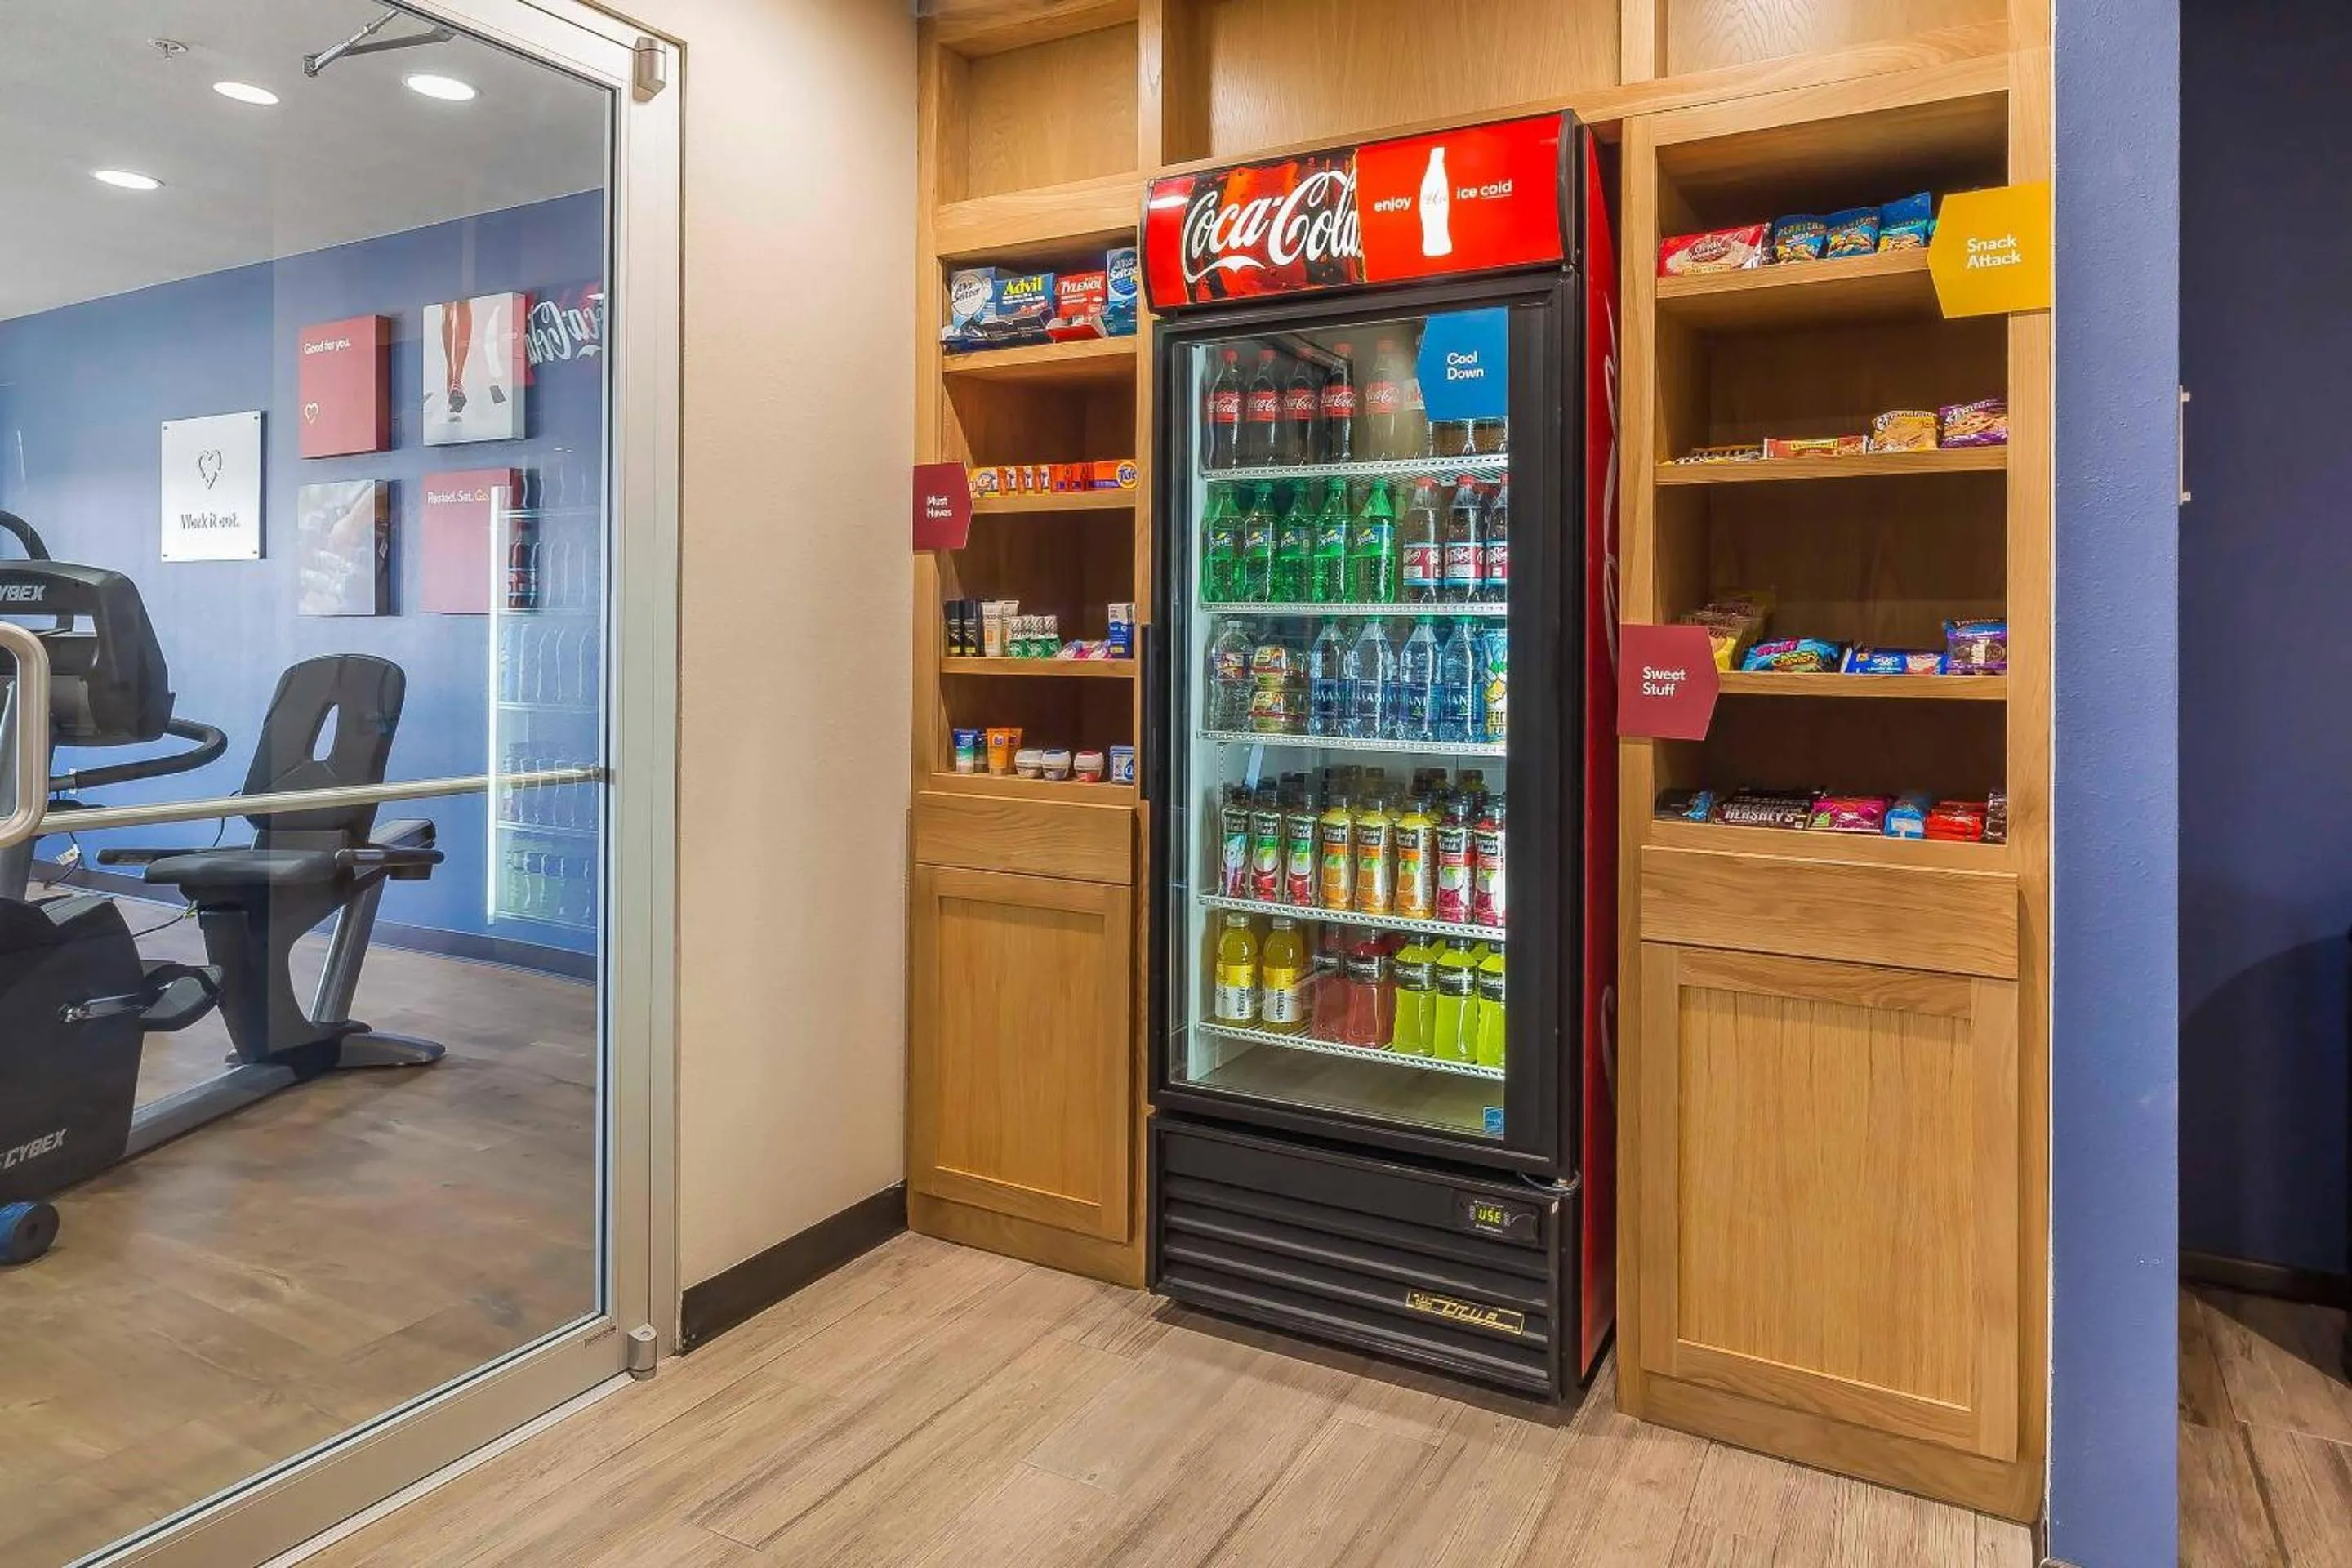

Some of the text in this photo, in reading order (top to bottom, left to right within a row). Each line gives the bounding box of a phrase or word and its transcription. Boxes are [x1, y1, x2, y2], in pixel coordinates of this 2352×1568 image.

[1456, 187, 1477, 199] ice
[1480, 180, 1512, 197] cold
[1374, 197, 1412, 212] enjoy
[1183, 170, 1362, 283] Coca-Cola
[1967, 234, 2017, 252] Snack
[1967, 249, 2023, 270] Attack
[1110, 267, 1137, 282] Seltze
[1004, 276, 1042, 295] Advil
[1060, 279, 1102, 295] TYLENOL
[303, 341, 323, 354] Good
[1446, 350, 1478, 365] Cool
[1446, 368, 1485, 381] Down
[926, 495, 948, 506] Must
[926, 506, 953, 519] Haves
[180, 512, 208, 529] Work
[0, 584, 47, 602] YBEX
[1642, 666, 1686, 681] Sweet
[1642, 681, 1676, 697] Stuff
[1725, 810, 1795, 823] HERSHEY'S
[3, 1128, 68, 1169] CYBEX
[1477, 1209, 1502, 1224] USE
